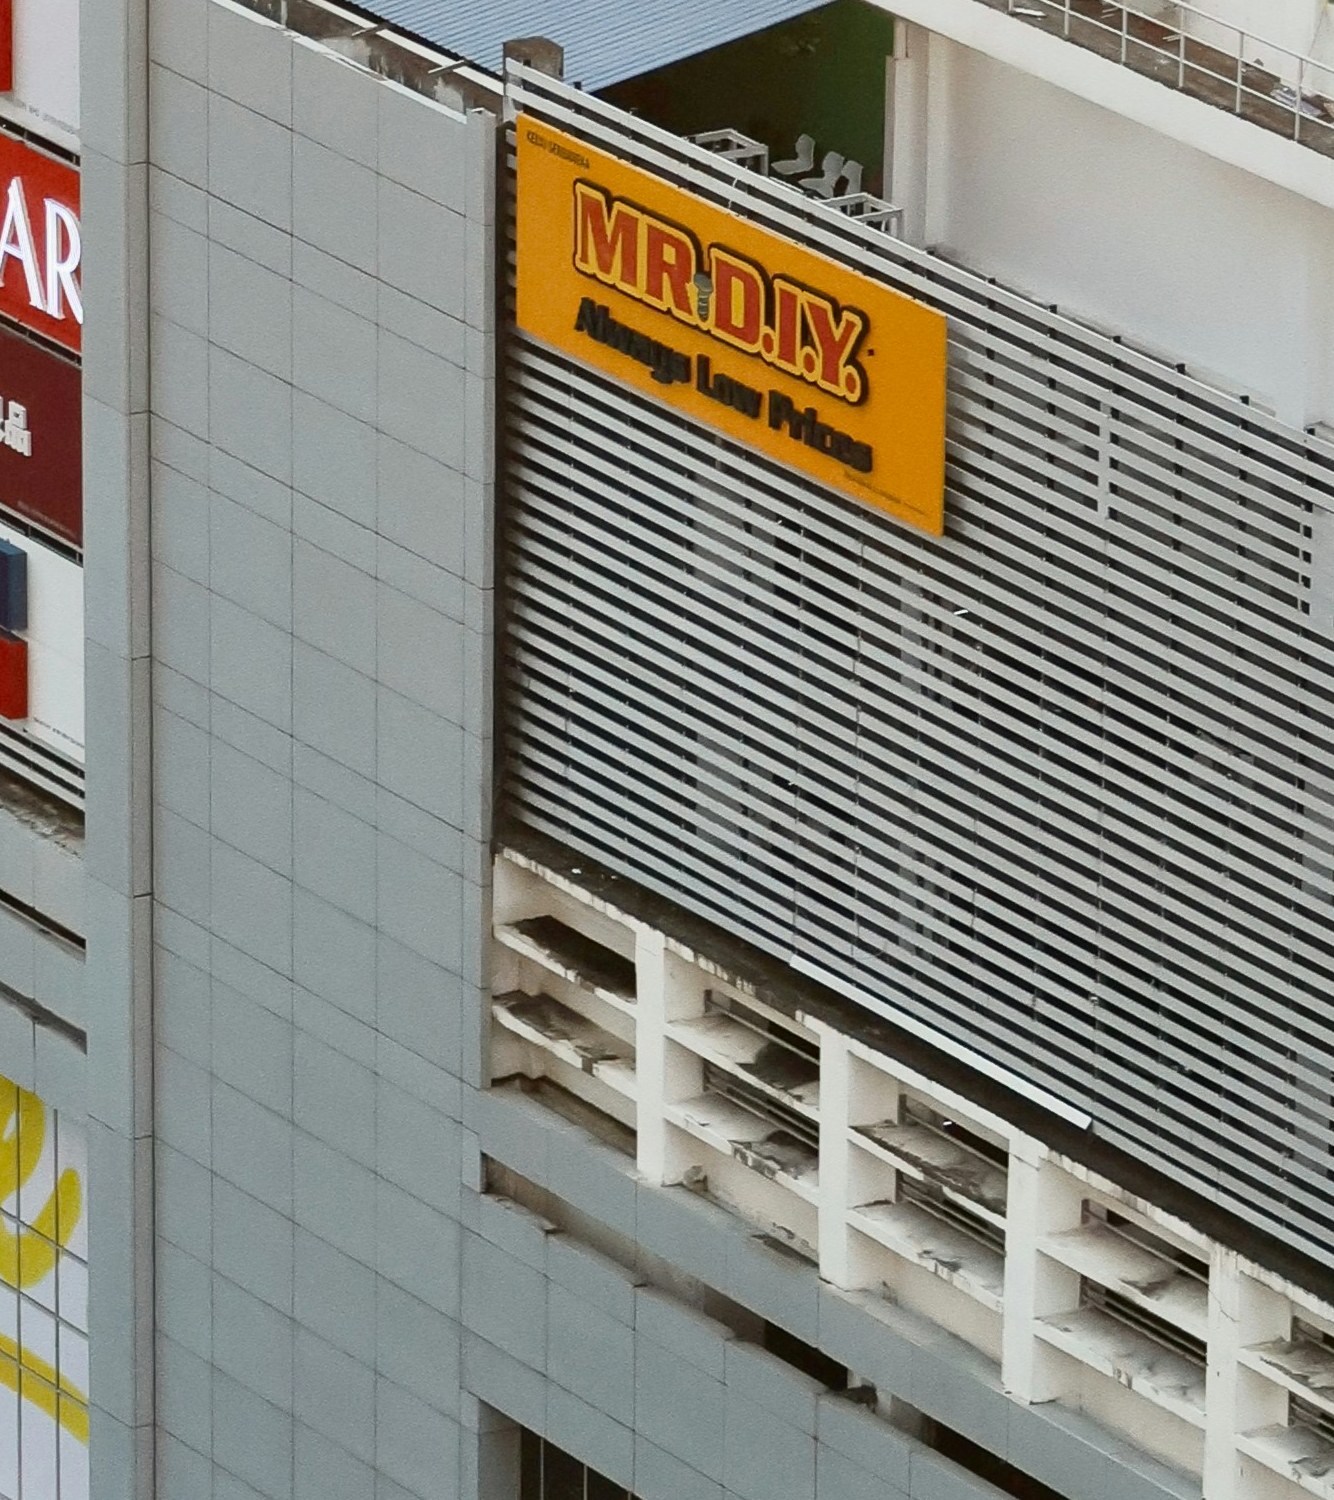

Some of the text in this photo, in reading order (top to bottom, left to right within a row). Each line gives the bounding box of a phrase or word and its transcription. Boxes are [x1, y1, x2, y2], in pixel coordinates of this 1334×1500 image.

[573, 297, 873, 474] Always Low Prices
